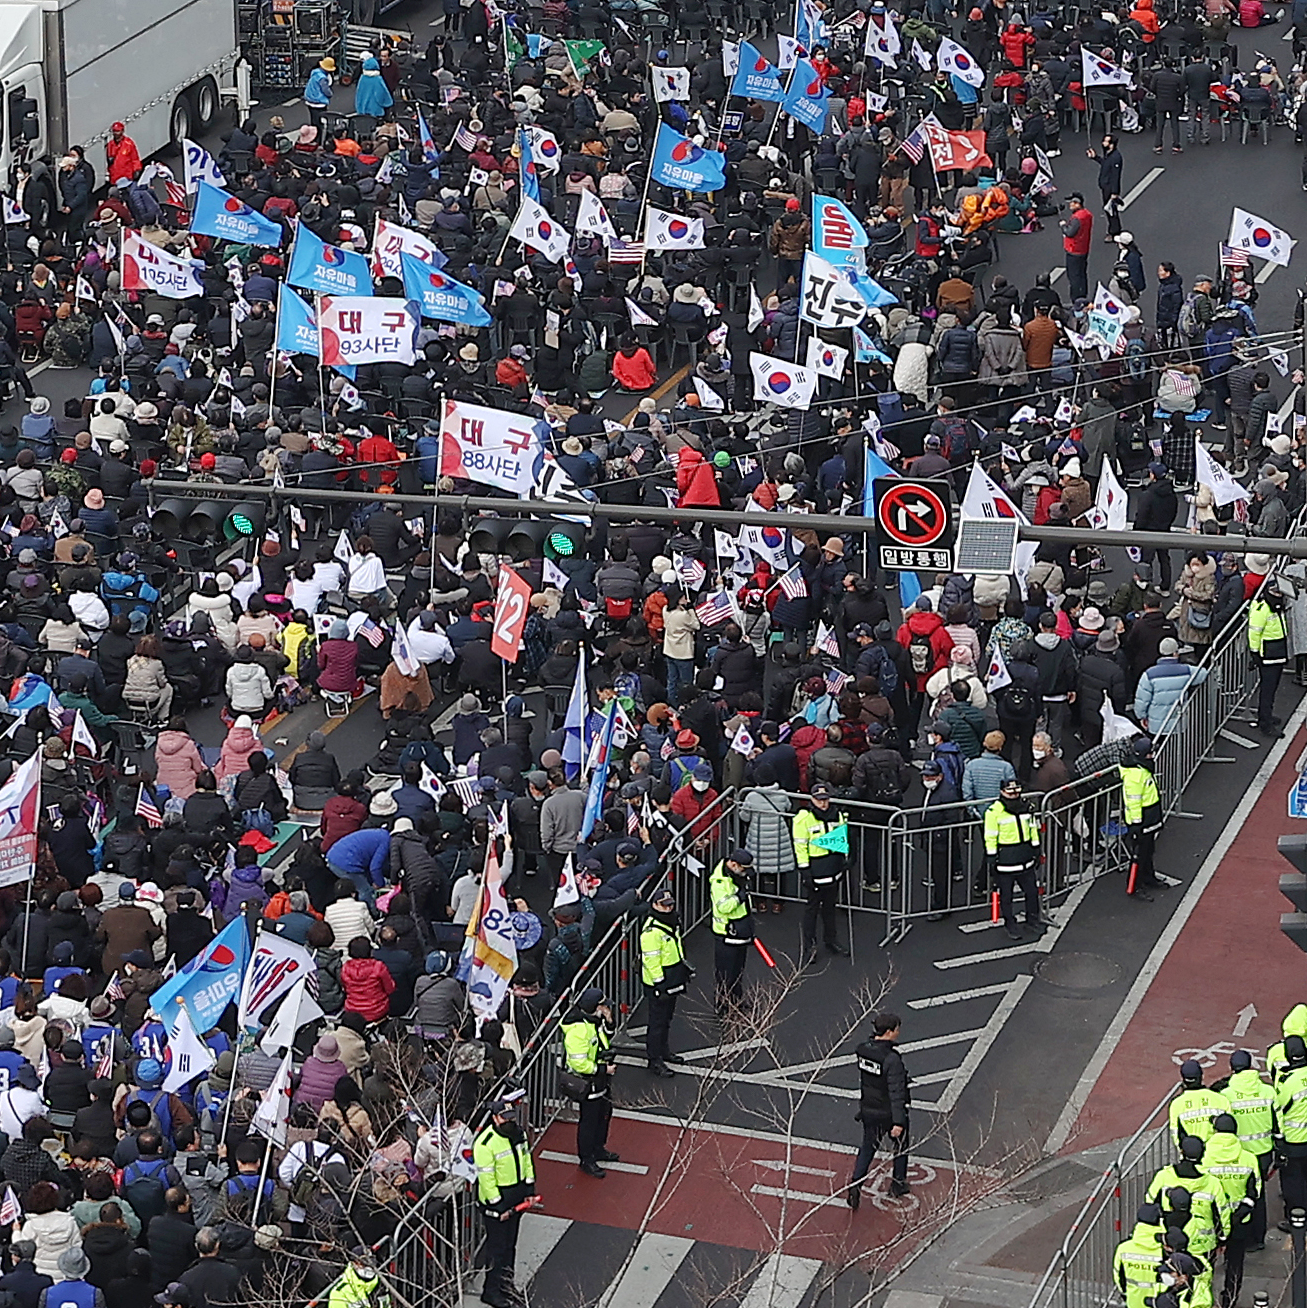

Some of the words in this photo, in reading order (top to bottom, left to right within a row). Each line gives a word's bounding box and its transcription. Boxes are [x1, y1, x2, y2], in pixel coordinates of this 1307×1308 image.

[746, 74, 780, 91] 자유마을
[661, 163, 704, 185] 자유마을
[214, 212, 260, 234] 자유마을
[141, 265, 188, 291] 105사단
[313, 264, 357, 286] 자유마을
[422, 290, 469, 312] 자유마을
[338, 310, 406, 334] 대구
[340, 335, 401, 355] 93사단
[461, 417, 532, 456] 대구
[462, 450, 522, 481] 88사단
[884, 549, 947, 567] 일방통행
